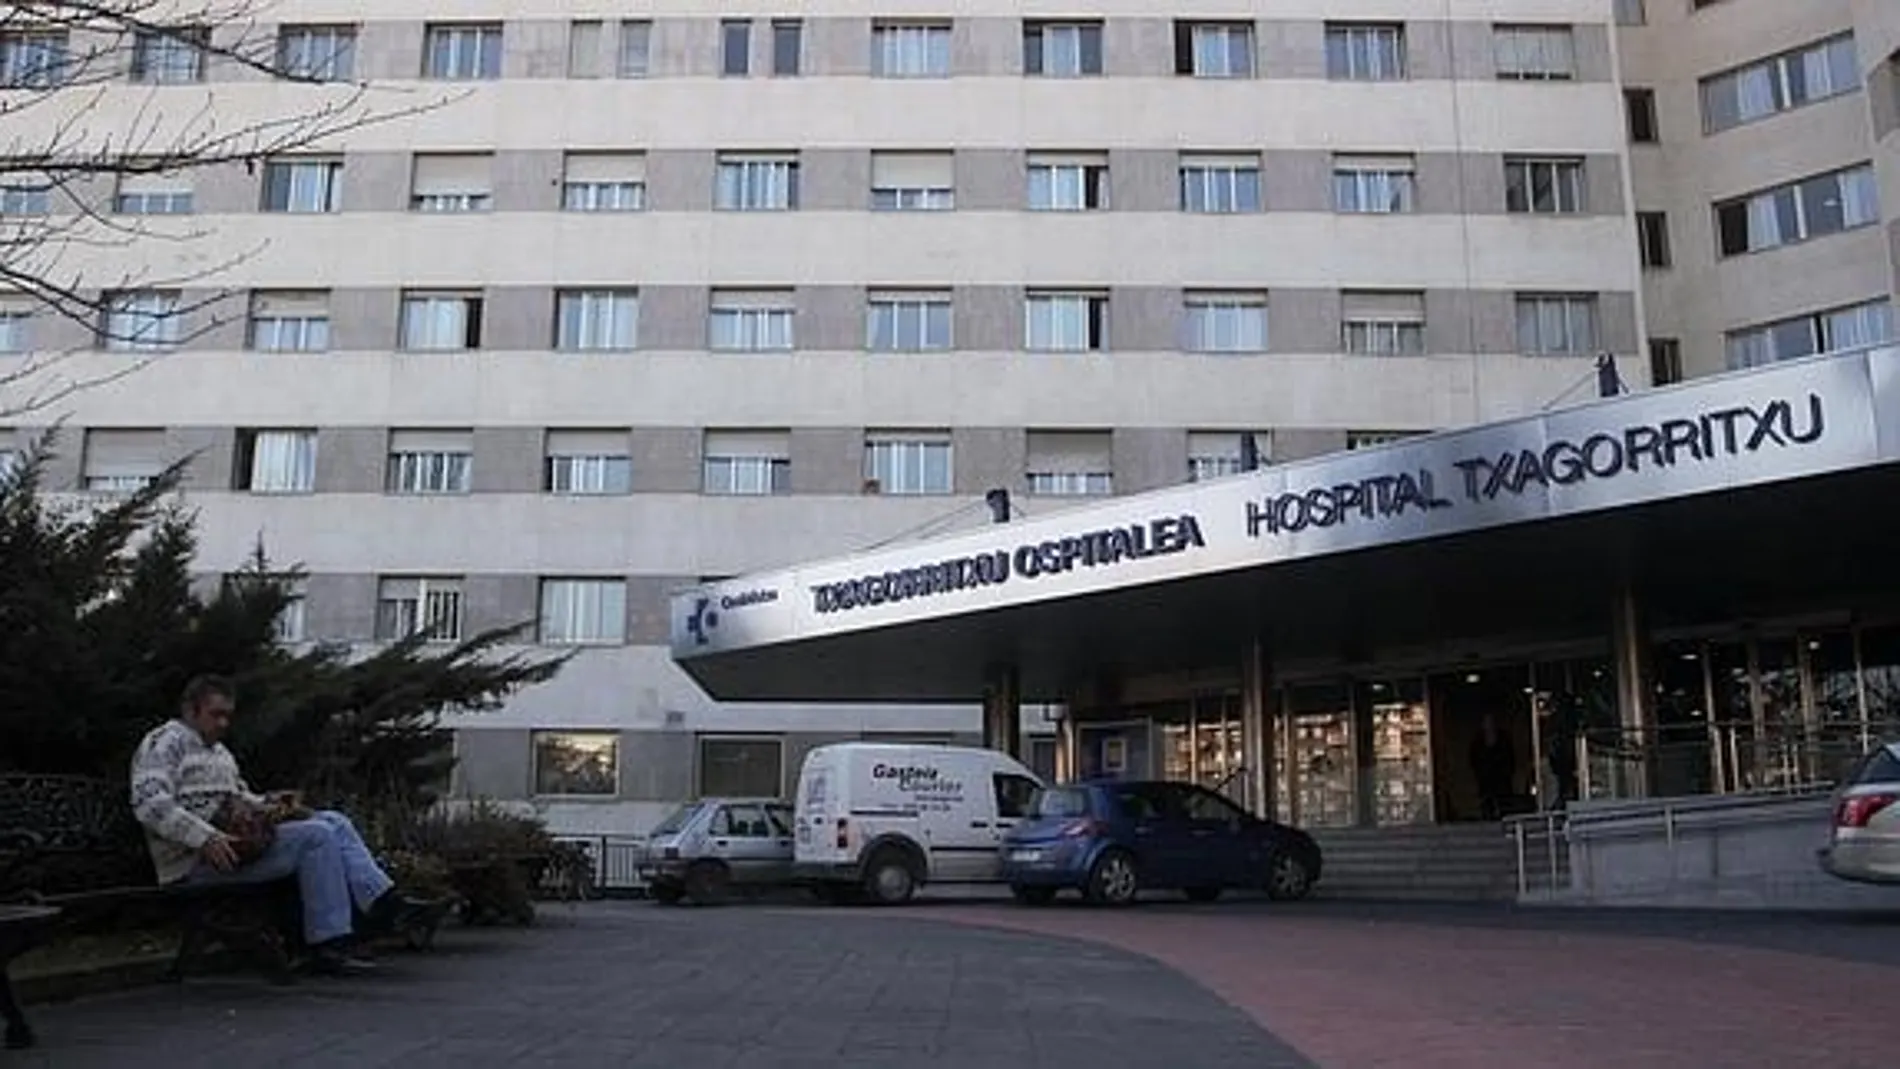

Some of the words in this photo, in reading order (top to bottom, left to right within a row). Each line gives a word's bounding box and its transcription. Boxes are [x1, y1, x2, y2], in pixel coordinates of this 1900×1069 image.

[1246, 468, 1453, 537] HOSPITAL
[1453, 394, 1826, 501] TXAGORRITXU
[810, 549, 1010, 614] TXAGORRITXU
[1013, 513, 1206, 579] OSPITALEA
